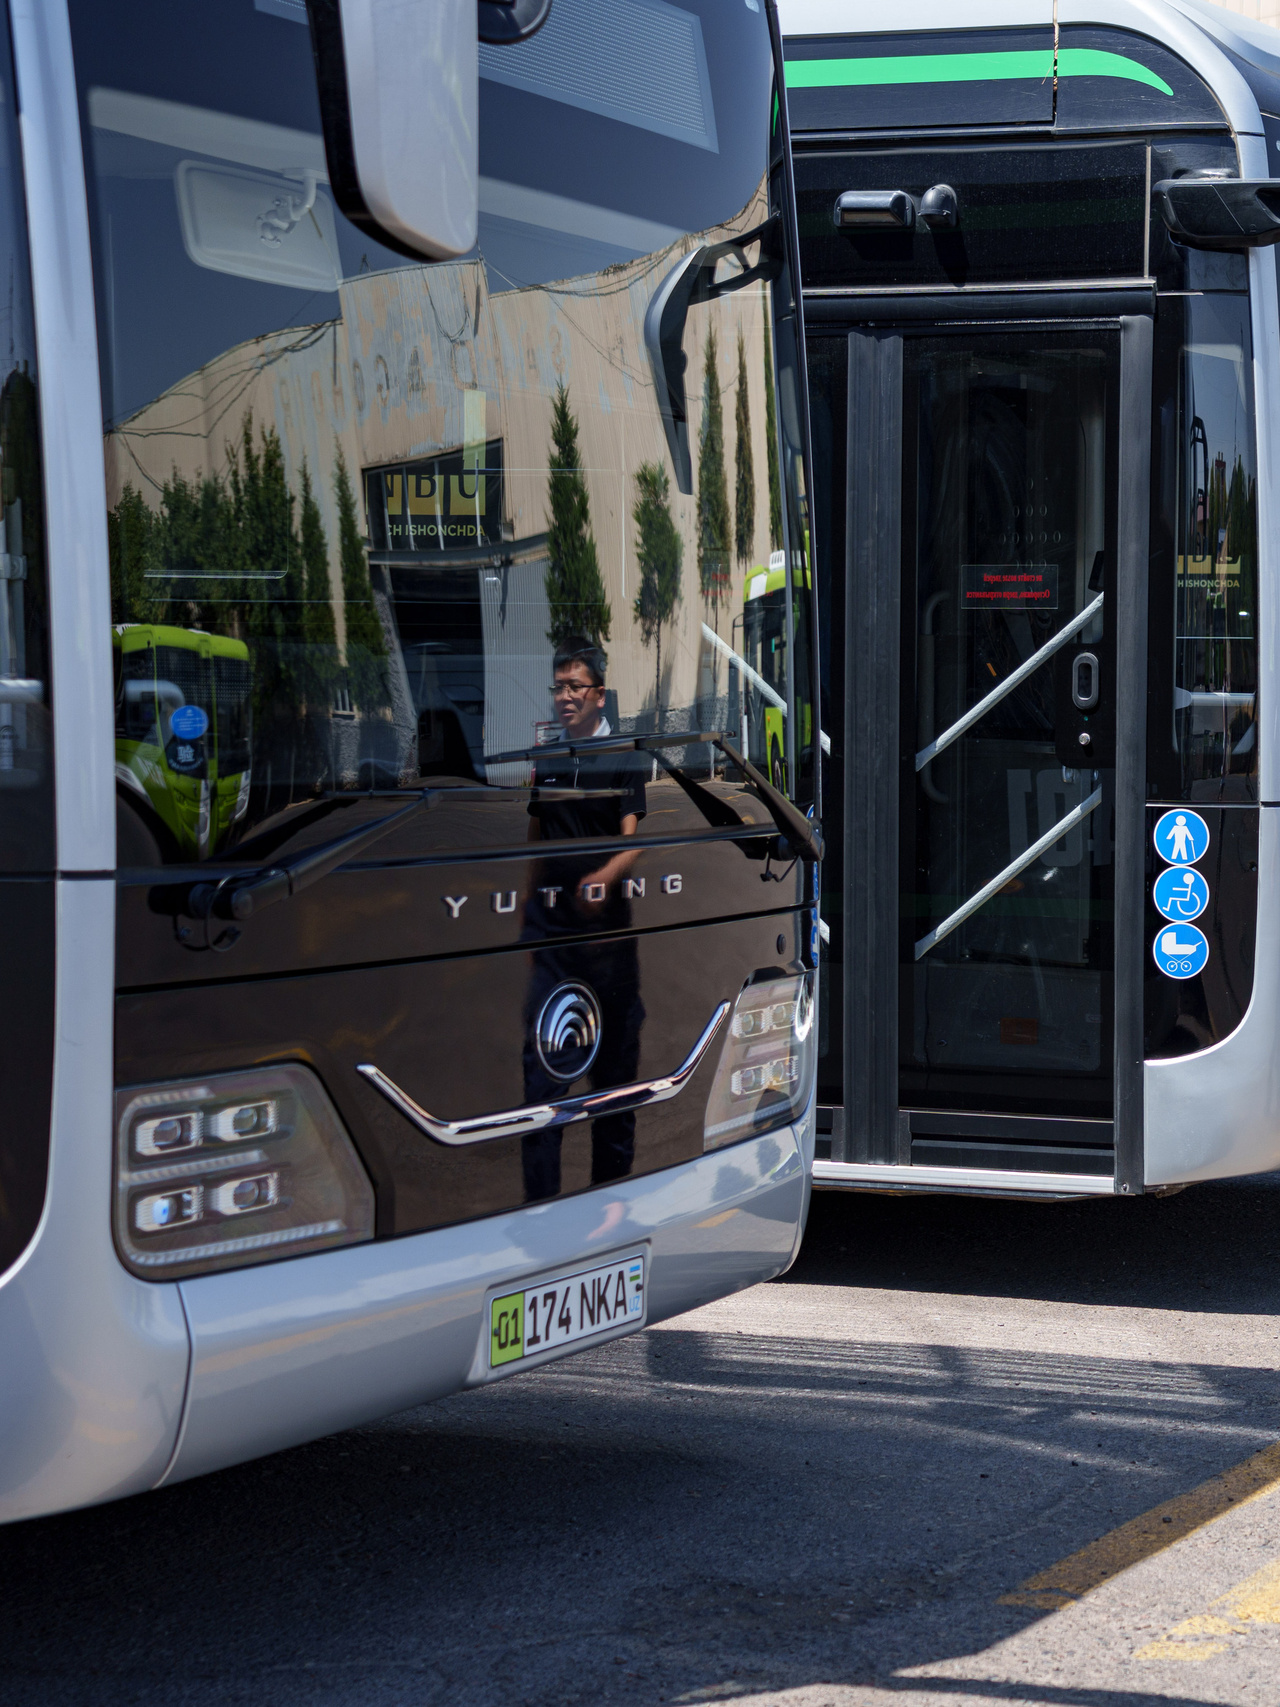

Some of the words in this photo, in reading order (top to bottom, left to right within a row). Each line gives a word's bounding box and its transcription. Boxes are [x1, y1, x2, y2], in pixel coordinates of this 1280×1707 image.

[405, 524, 486, 537] ISHONCHDA
[1185, 580, 1240, 588] ISHONCHDA
[443, 874, 683, 918] YUTONG
[498, 1307, 521, 1350] 01
[526, 1286, 572, 1347] 174
[579, 1269, 628, 1330] NKA
[629, 1295, 641, 1313] UZ
